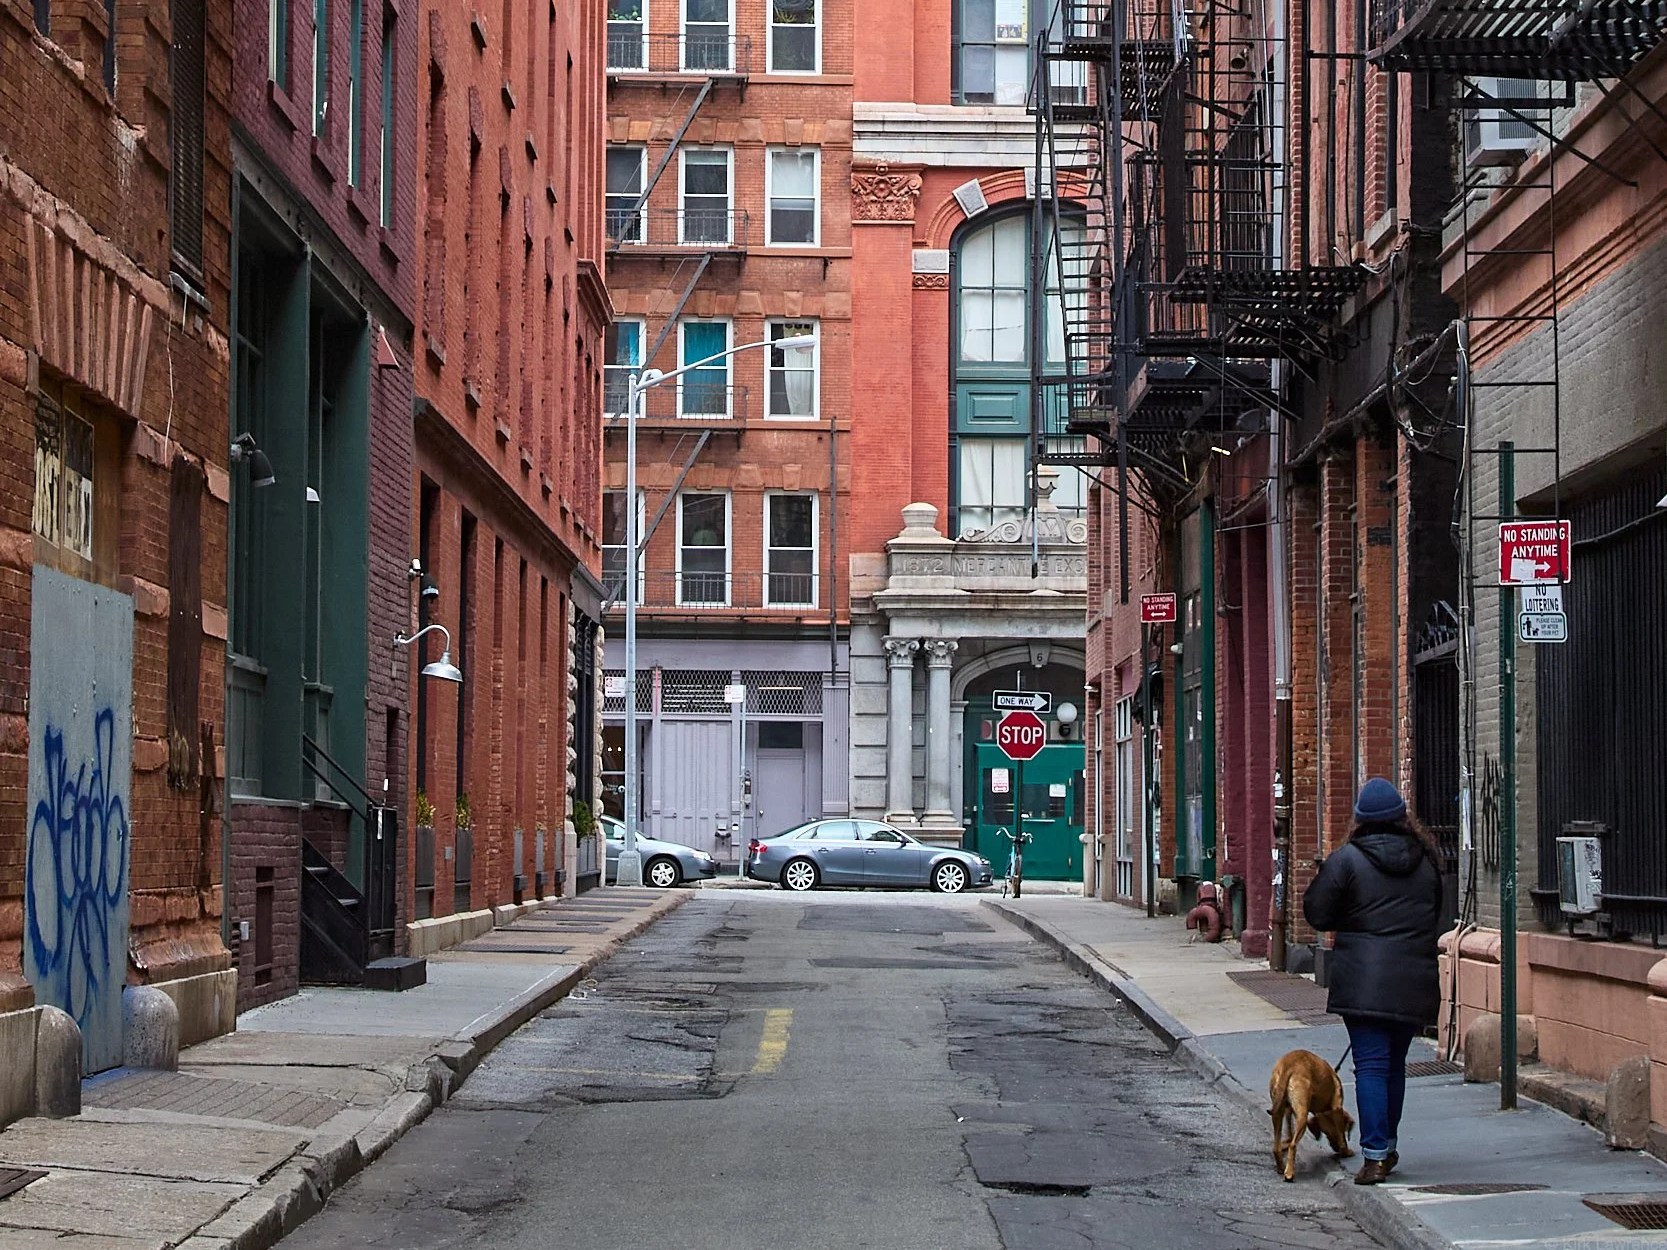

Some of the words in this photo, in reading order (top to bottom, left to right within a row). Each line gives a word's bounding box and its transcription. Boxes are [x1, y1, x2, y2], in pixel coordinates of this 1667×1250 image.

[1504, 529, 1517, 542] NO
[1520, 527, 1566, 541] STANDING
[1511, 544, 1558, 558] ANYTIME
[902, 556, 945, 572] 1872
[953, 557, 1048, 573] MERCANTIE
[1535, 583, 1547, 596] NO
[1525, 597, 1559, 611] LOITERING
[1036, 652, 1043, 662] 6
[1000, 696, 1016, 705] ONE
[1018, 697, 1034, 706] WAY
[1001, 725, 1042, 745] STOP
